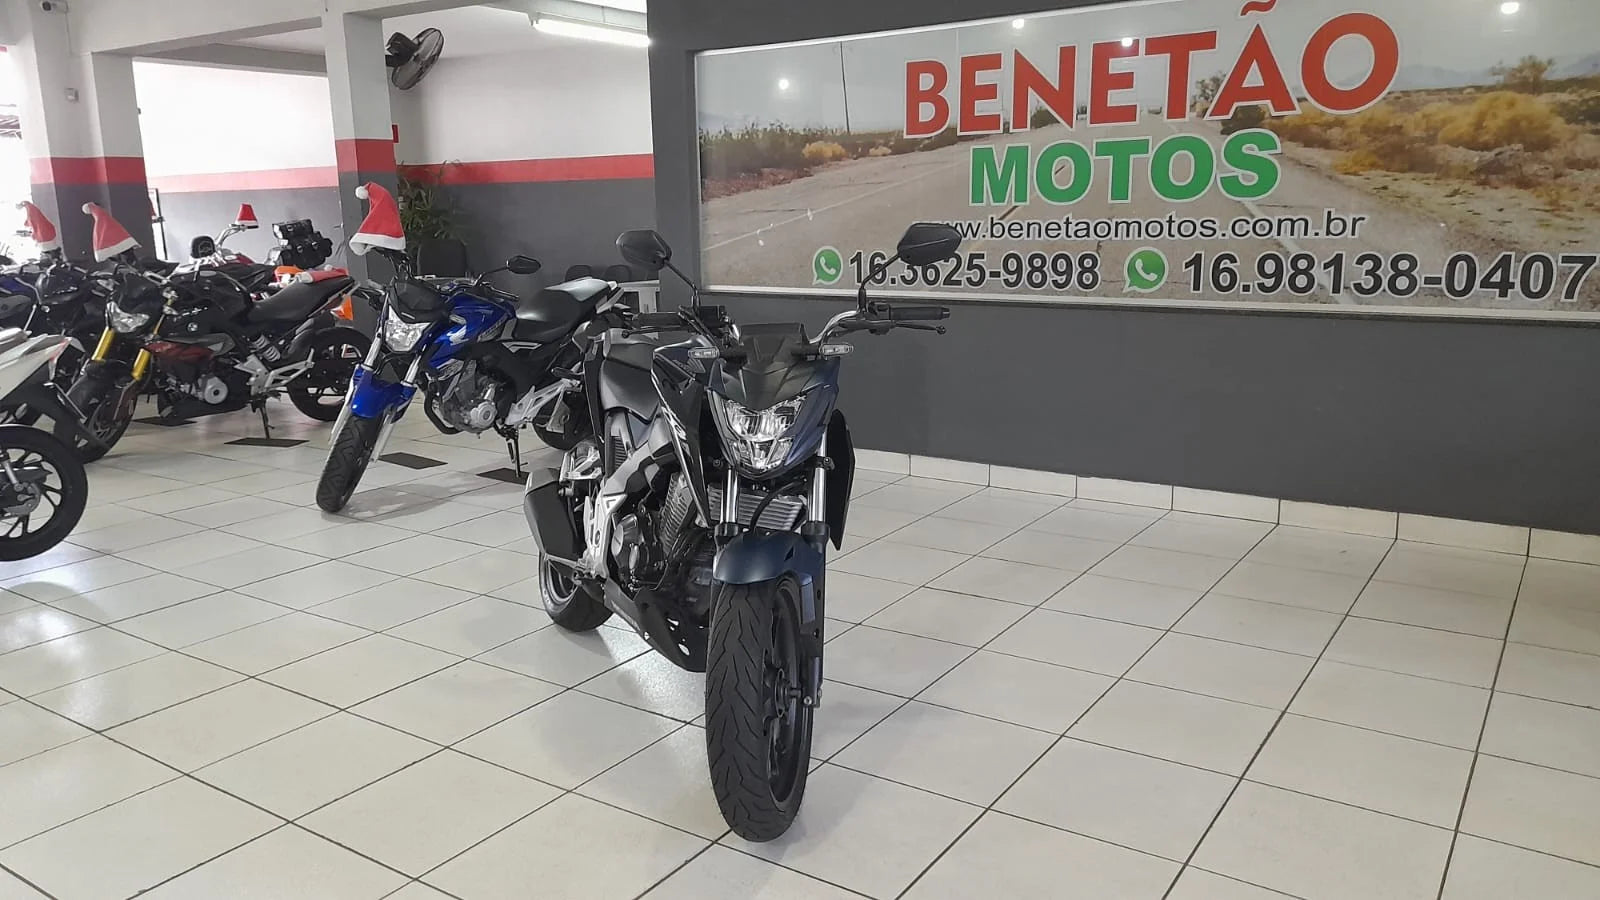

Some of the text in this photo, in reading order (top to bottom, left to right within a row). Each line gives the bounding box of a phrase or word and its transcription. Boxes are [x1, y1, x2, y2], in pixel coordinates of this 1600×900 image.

[905, 0, 1400, 136] BENETÃO
[970, 131, 1280, 205] MOTOS
[945, 211, 1366, 240] w.benetaomotos.com.br
[1183, 252, 1597, 300] 16.98138-0407
